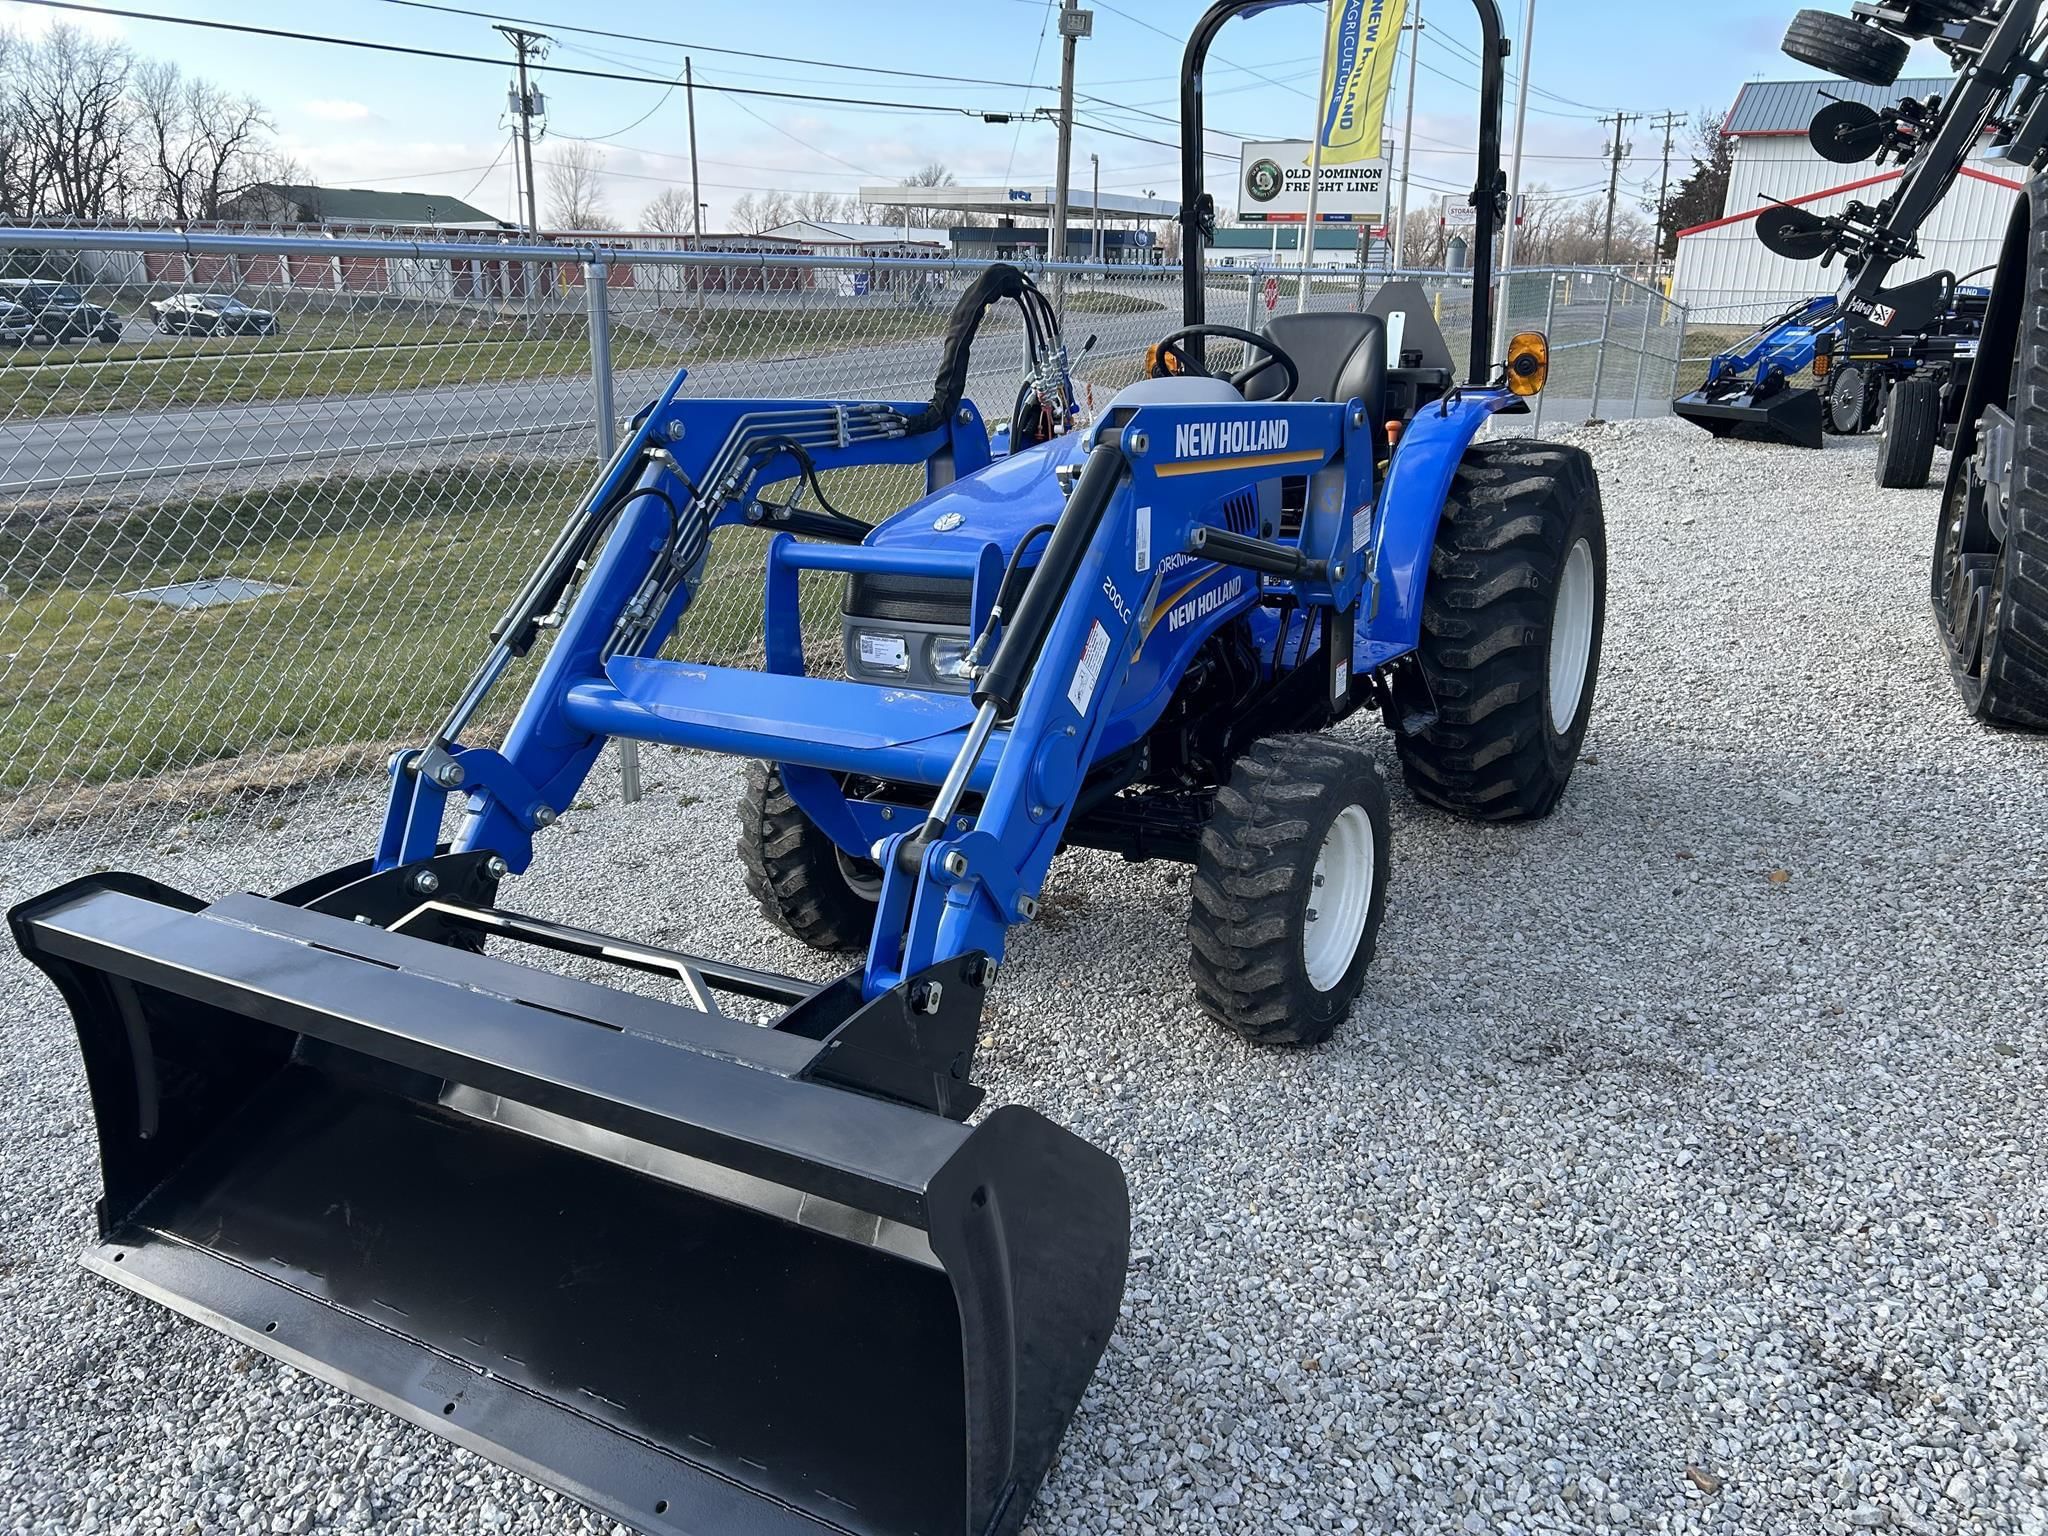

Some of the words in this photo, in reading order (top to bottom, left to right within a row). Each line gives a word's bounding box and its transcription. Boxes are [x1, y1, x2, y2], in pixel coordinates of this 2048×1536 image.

[1366, 0, 1384, 42] NEW
[1333, 0, 1360, 103] AGRICULTURE
[1285, 168, 1311, 179] OLD
[1318, 168, 1382, 179] DOMINION
[1285, 182, 1344, 192] FREGHT
[1346, 182, 1378, 192] LINE
[1451, 207, 1474, 215] STORAG
[1175, 422, 1217, 458] NEW
[1219, 419, 1289, 454] HOLLAND
[1102, 575, 1132, 625] 200LC
[1169, 599, 1196, 632] NEW
[1198, 575, 1242, 617] HOLLAND
